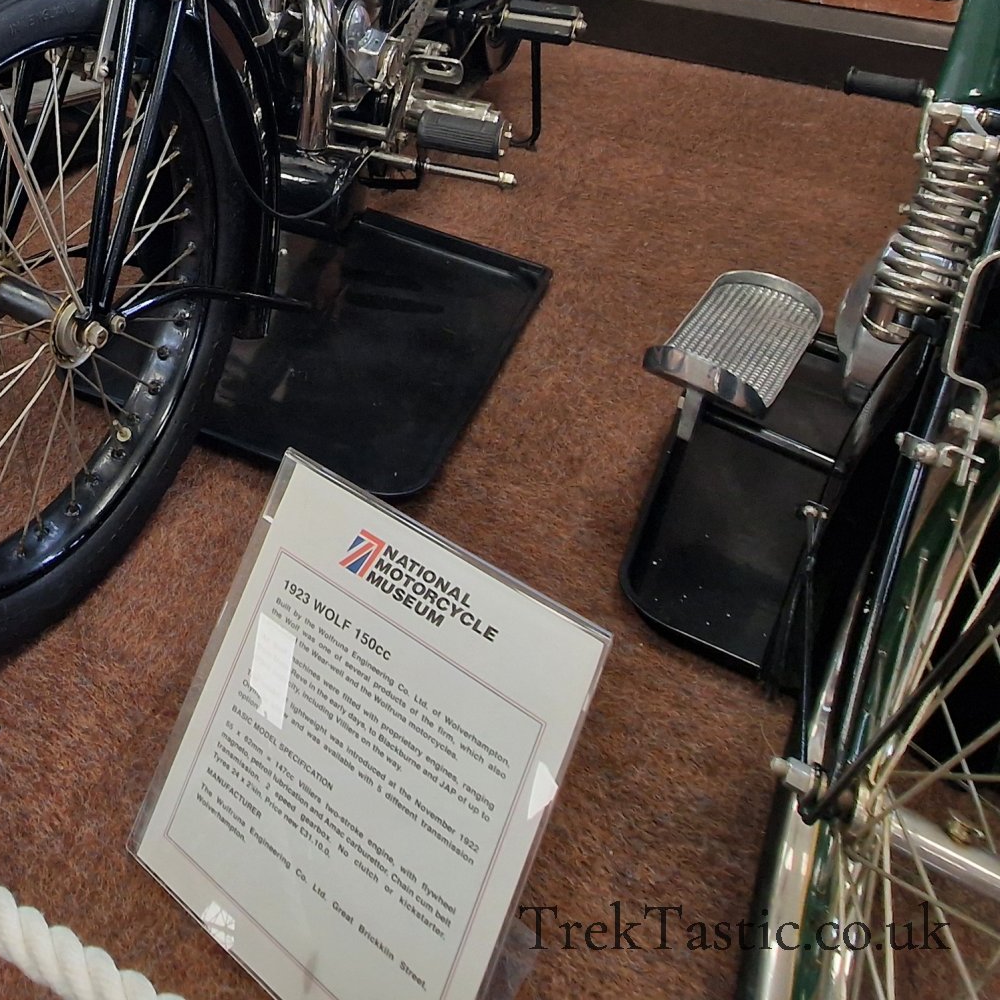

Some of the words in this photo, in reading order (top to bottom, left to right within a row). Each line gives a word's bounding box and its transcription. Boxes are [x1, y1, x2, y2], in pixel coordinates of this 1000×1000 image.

[284, 580, 311, 605] 1923
[314, 598, 352, 630] WOLF
[355, 628, 391, 661] 150cc
[367, 571, 444, 626] MUSEUM
[375, 559, 498, 641] MOTORCYCLE
[384, 546, 470, 607] NATIONAL
[276, 597, 291, 612] Built
[351, 650, 395, 687] Engineering
[397, 683, 410, 697] Co.
[414, 694, 428, 710] Ltd.
[445, 715, 509, 768] Wolverhampton,
[285, 616, 300, 632] Wolf
[344, 661, 371, 683] several
[372, 681, 406, 708] products
[409, 707, 419, 717] of
[421, 714, 435, 728] the
[437, 726, 455, 745] firm,
[460, 742, 484, 764] which
[488, 763, 506, 779] also
[299, 640, 310, 653] the
[311, 649, 345, 678] Wear-well
[345, 675, 360, 689] and
[360, 684, 372, 698] the
[408, 721, 457, 760] motorcycles.
[302, 691, 334, 720] including
[336, 715, 360, 739] Villiers
[360, 736, 371, 747] on
[372, 744, 385, 758] the
[386, 755, 402, 772] way.
[323, 679, 340, 695] were
[342, 692, 361, 711] fitted
[363, 709, 379, 724] with
[380, 722, 423, 757] proprietary
[425, 755, 458, 785] engines,
[462, 783, 495, 812] ranging
[207, 767, 262, 819] MANUFACTURER
[213, 751, 230, 770] Tyres
[231, 767, 240, 778] 24
[264, 796, 283, 816] Price
[283, 813, 299, 829] new
[299, 826, 330, 858] £31.10.0.
[232, 704, 253, 725] BASIC
[253, 722, 277, 746] MODEL
[279, 743, 333, 791] SPECIFICATION
[290, 702, 327, 736] lightweight
[329, 733, 344, 749] was
[346, 745, 386, 781] introduced
[388, 780, 397, 790] at
[399, 786, 412, 801] the
[414, 798, 456, 834] November
[460, 834, 479, 853] 1922
[291, 718, 305, 732] and
[307, 730, 321, 745] was
[323, 744, 355, 772] available
[358, 770, 374, 787] with
[385, 792, 418, 821] different
[421, 819, 474, 865] transmission
[308, 681, 316, 692] in
[316, 688, 329, 701] the
[329, 698, 347, 715] early
[347, 712, 367, 732] days,
[368, 726, 377, 737] to
[378, 733, 421, 770] Blackburne
[422, 768, 439, 783] and
[439, 780, 457, 795] JAP
[457, 794, 467, 804] of
[468, 802, 480, 814] up
[481, 811, 490, 822] to
[197, 793, 245, 842] Wolverhampton.
[217, 741, 260, 782] transmission.
[274, 791, 296, 813] speed
[300, 813, 331, 843] gearbox.
[337, 843, 349, 857] No
[354, 859, 379, 883] clutch
[384, 884, 394, 895] or
[399, 896, 445, 940] kickstarter.
[221, 732, 249, 760] magneto,
[250, 756, 273, 777] petroil
[273, 773, 309, 808] lubrication
[309, 806, 324, 821] and
[324, 817, 345, 839] Amac
[346, 836, 388, 876] carburettor.
[391, 873, 414, 897] Chain
[415, 894, 434, 913] cum
[435, 909, 451, 928] belt
[244, 735, 263, 756] 62mm
[275, 761, 295, 781] 147cc
[298, 779, 322, 804] Villiers
[325, 802, 364, 839] two-stroke
[367, 839, 395, 867] engine,
[400, 866, 417, 884] with
[421, 882, 456, 915] flywheel
[201, 782, 213, 797] The
[249, 826, 291, 869] Engineering
[295, 868, 307, 883] Co.
[312, 883, 326, 901] Ltd.
[332, 901, 354, 925] Great
[358, 924, 394, 960] Brickkiln
[400, 961, 426, 991] Street,
